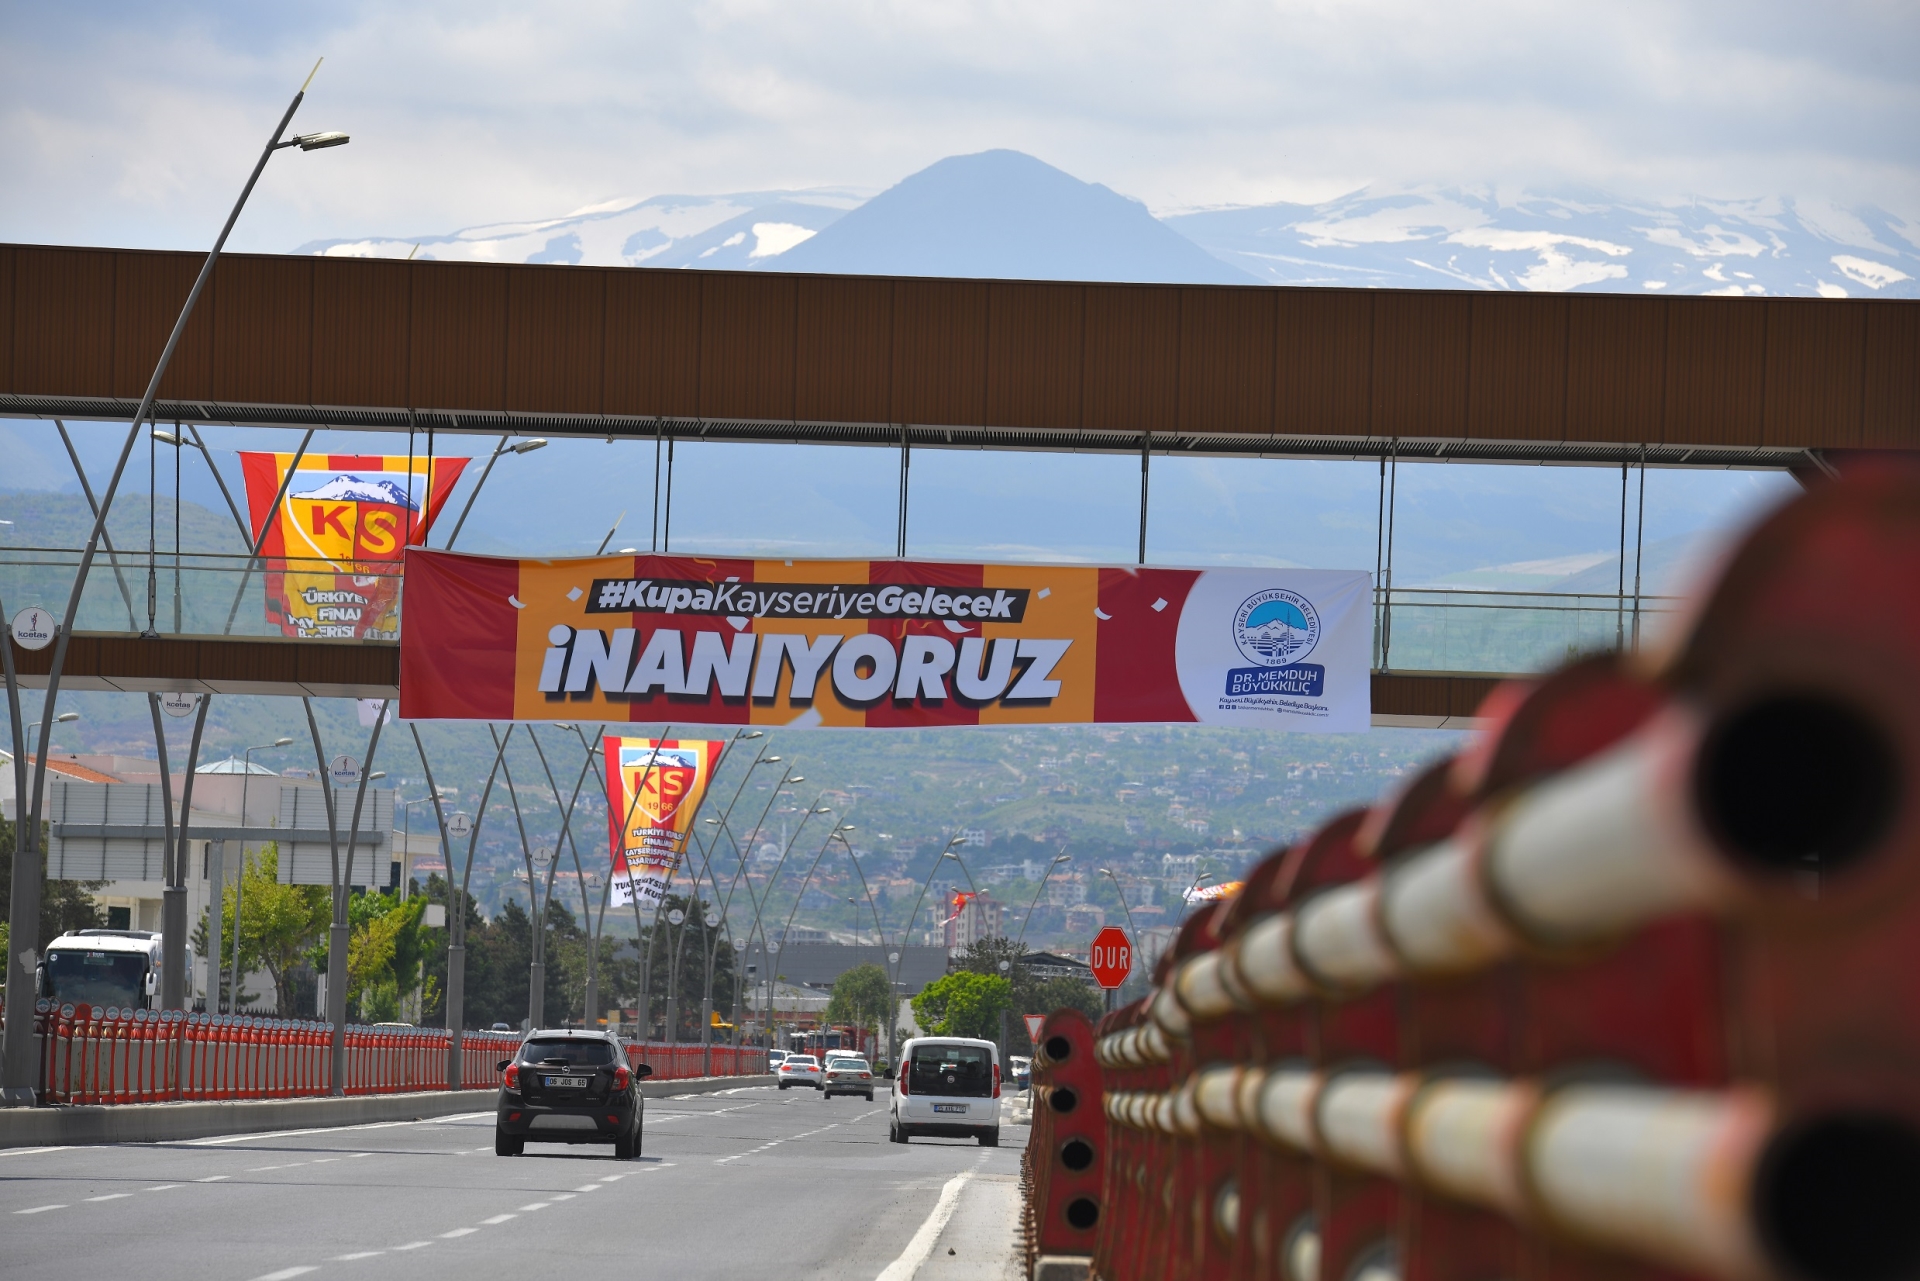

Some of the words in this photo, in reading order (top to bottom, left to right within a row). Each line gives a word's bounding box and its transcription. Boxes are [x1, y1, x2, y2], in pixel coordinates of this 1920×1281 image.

[311, 505, 398, 554] KS
[598, 580, 1016, 619] #KupaKayseriyeGelecek
[1238, 609, 1249, 646] KAYSERİ
[1246, 592, 1299, 610] BÜYÜKŞEHİR
[1299, 603, 1318, 646] BELEDİYESİ
[1265, 657, 1287, 665] 1869
[1233, 673, 1255, 684] DR.
[1258, 670, 1318, 682] MEMDUH
[1232, 680, 1311, 695] BÜYÜKKILIÇ
[633, 771, 684, 796] KS
[648, 802, 674, 812] 1966
[632, 827, 665, 837] TÜRKİYE
[1094, 945, 1129, 969] DUR
[577, 1079, 586, 1087] 65
